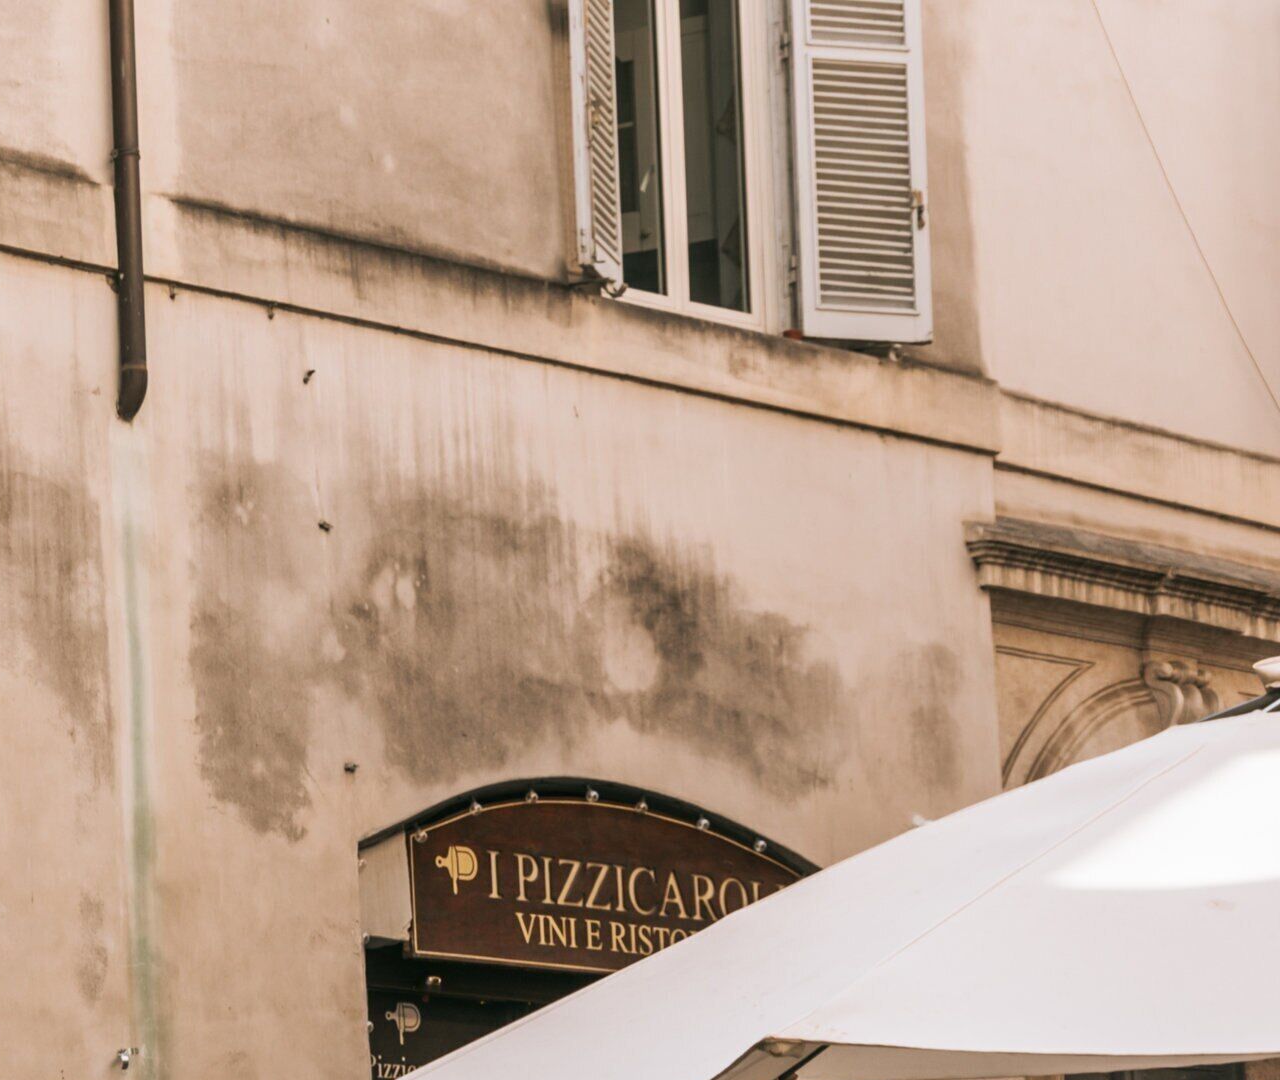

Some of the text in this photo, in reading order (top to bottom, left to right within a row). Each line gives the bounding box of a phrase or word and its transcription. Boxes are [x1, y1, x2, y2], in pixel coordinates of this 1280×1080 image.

[488, 851, 788, 921] I PIZZICARO
[516, 912, 696, 955] VINI E RISTO
